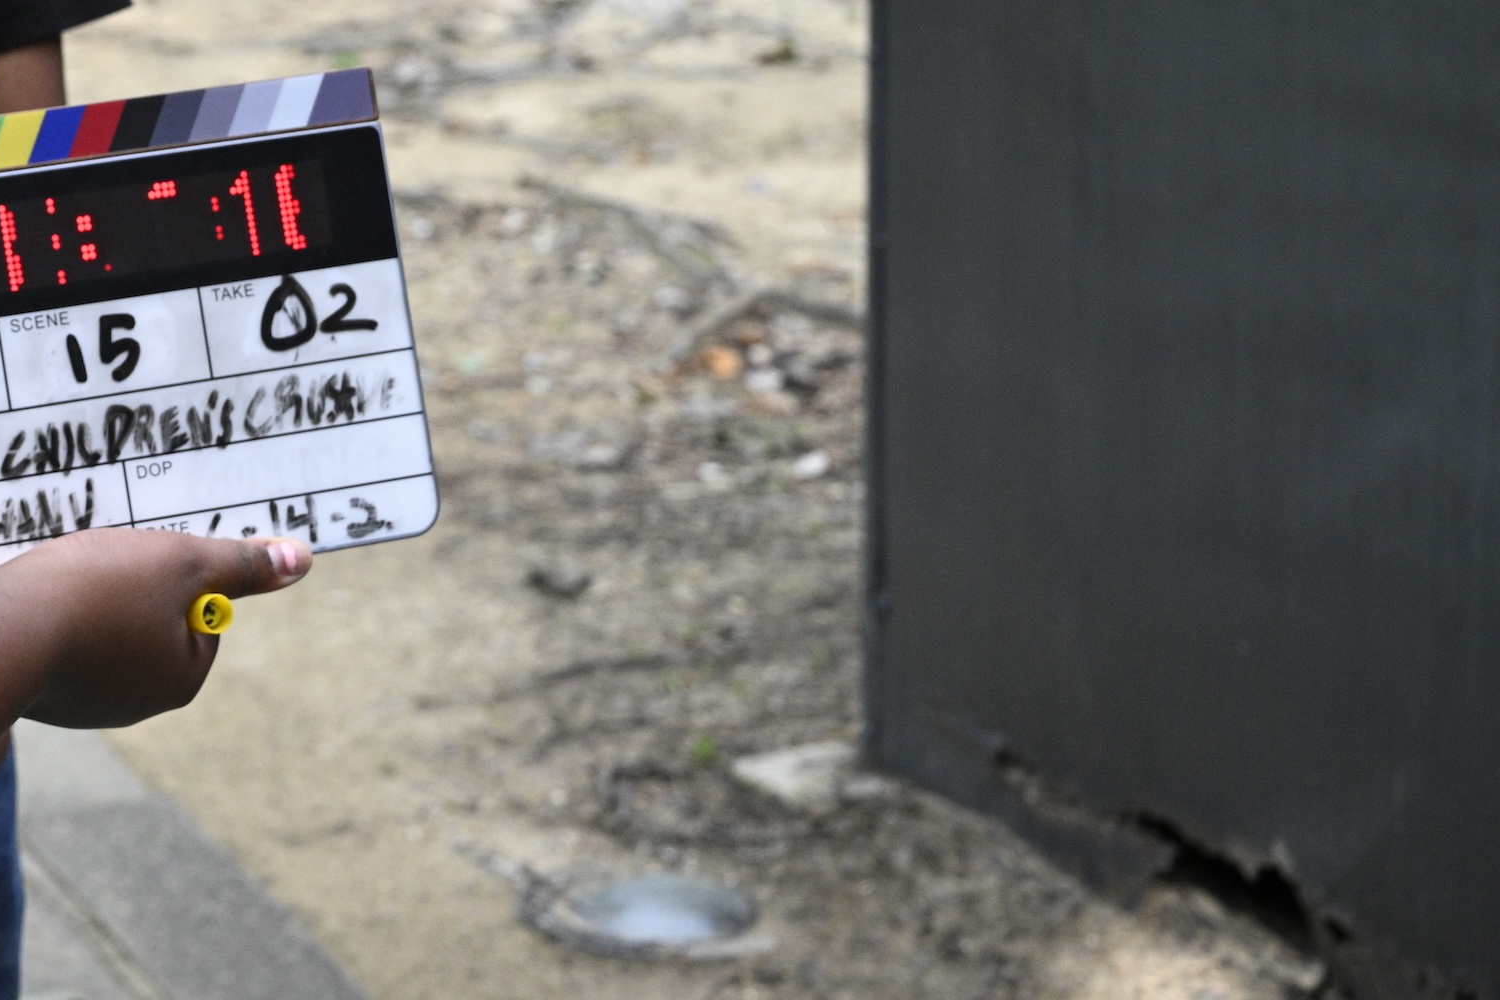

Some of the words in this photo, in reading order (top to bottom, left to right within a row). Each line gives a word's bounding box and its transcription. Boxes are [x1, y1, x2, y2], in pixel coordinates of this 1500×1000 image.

[212, 283, 255, 302] TAKE
[260, 275, 379, 352] 02
[10, 311, 70, 333] SCENE
[66, 313, 140, 383] 15
[1, 390, 234, 479] CHILDREN'S
[136, 460, 173, 479] DOP
